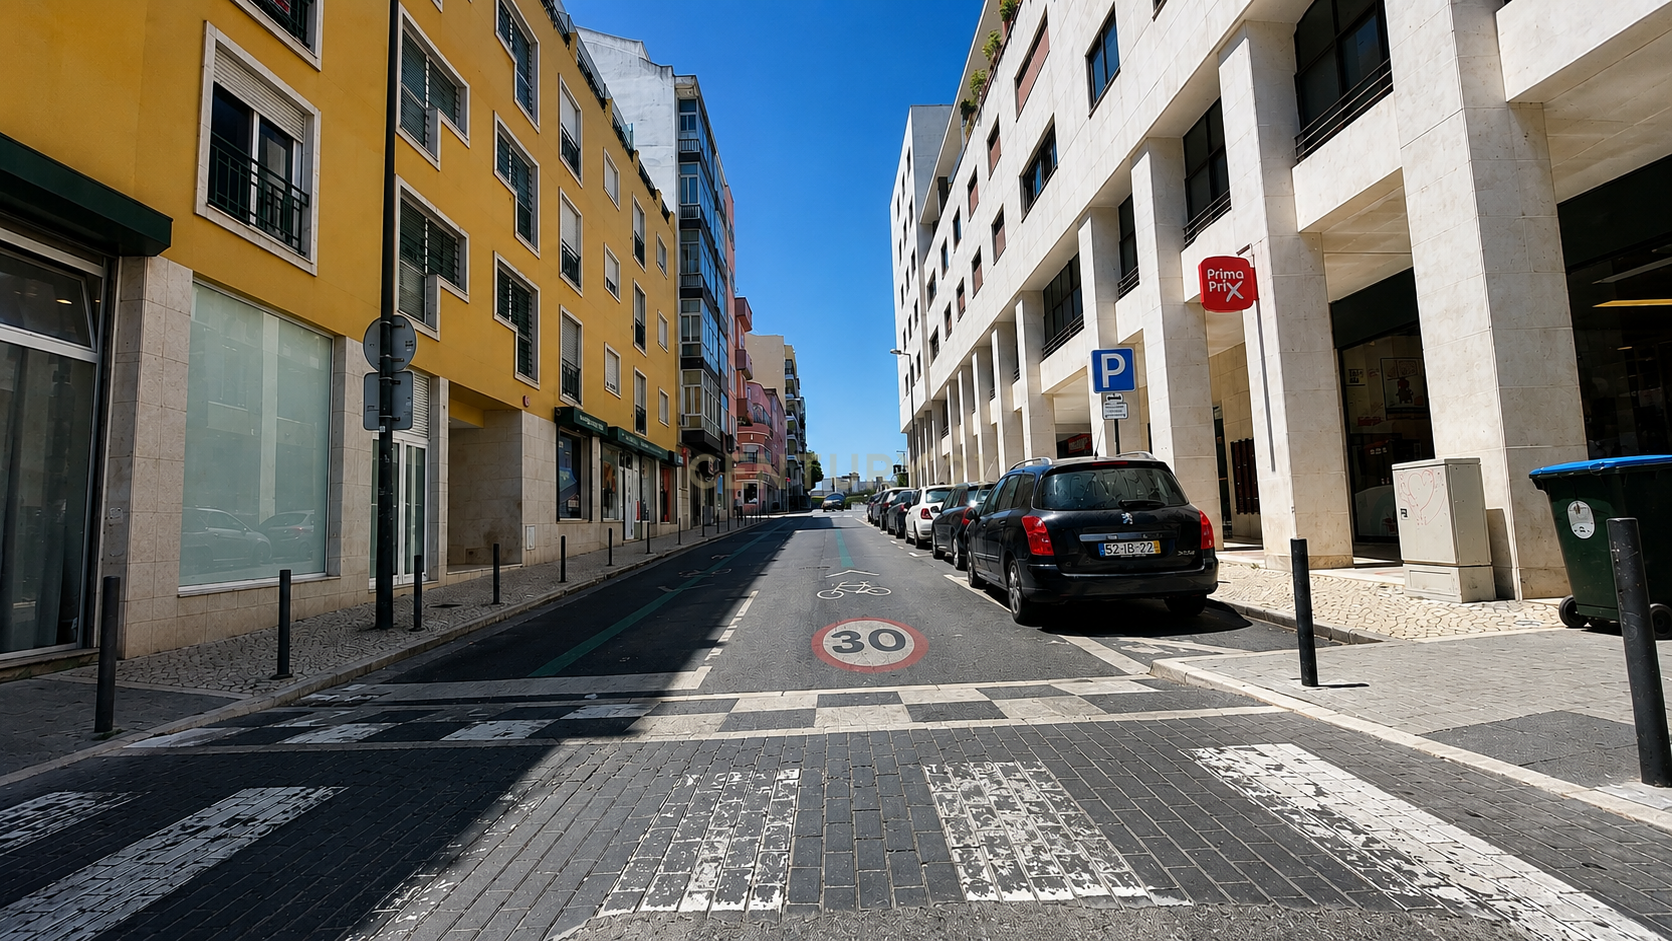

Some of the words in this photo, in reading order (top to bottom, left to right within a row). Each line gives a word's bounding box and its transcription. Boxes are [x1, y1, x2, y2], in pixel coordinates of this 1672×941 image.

[1207, 268, 1244, 280] Prima
[1100, 353, 1126, 388] P
[1105, 542, 1154, 555] 52-IB-22
[831, 628, 906, 653] 30
